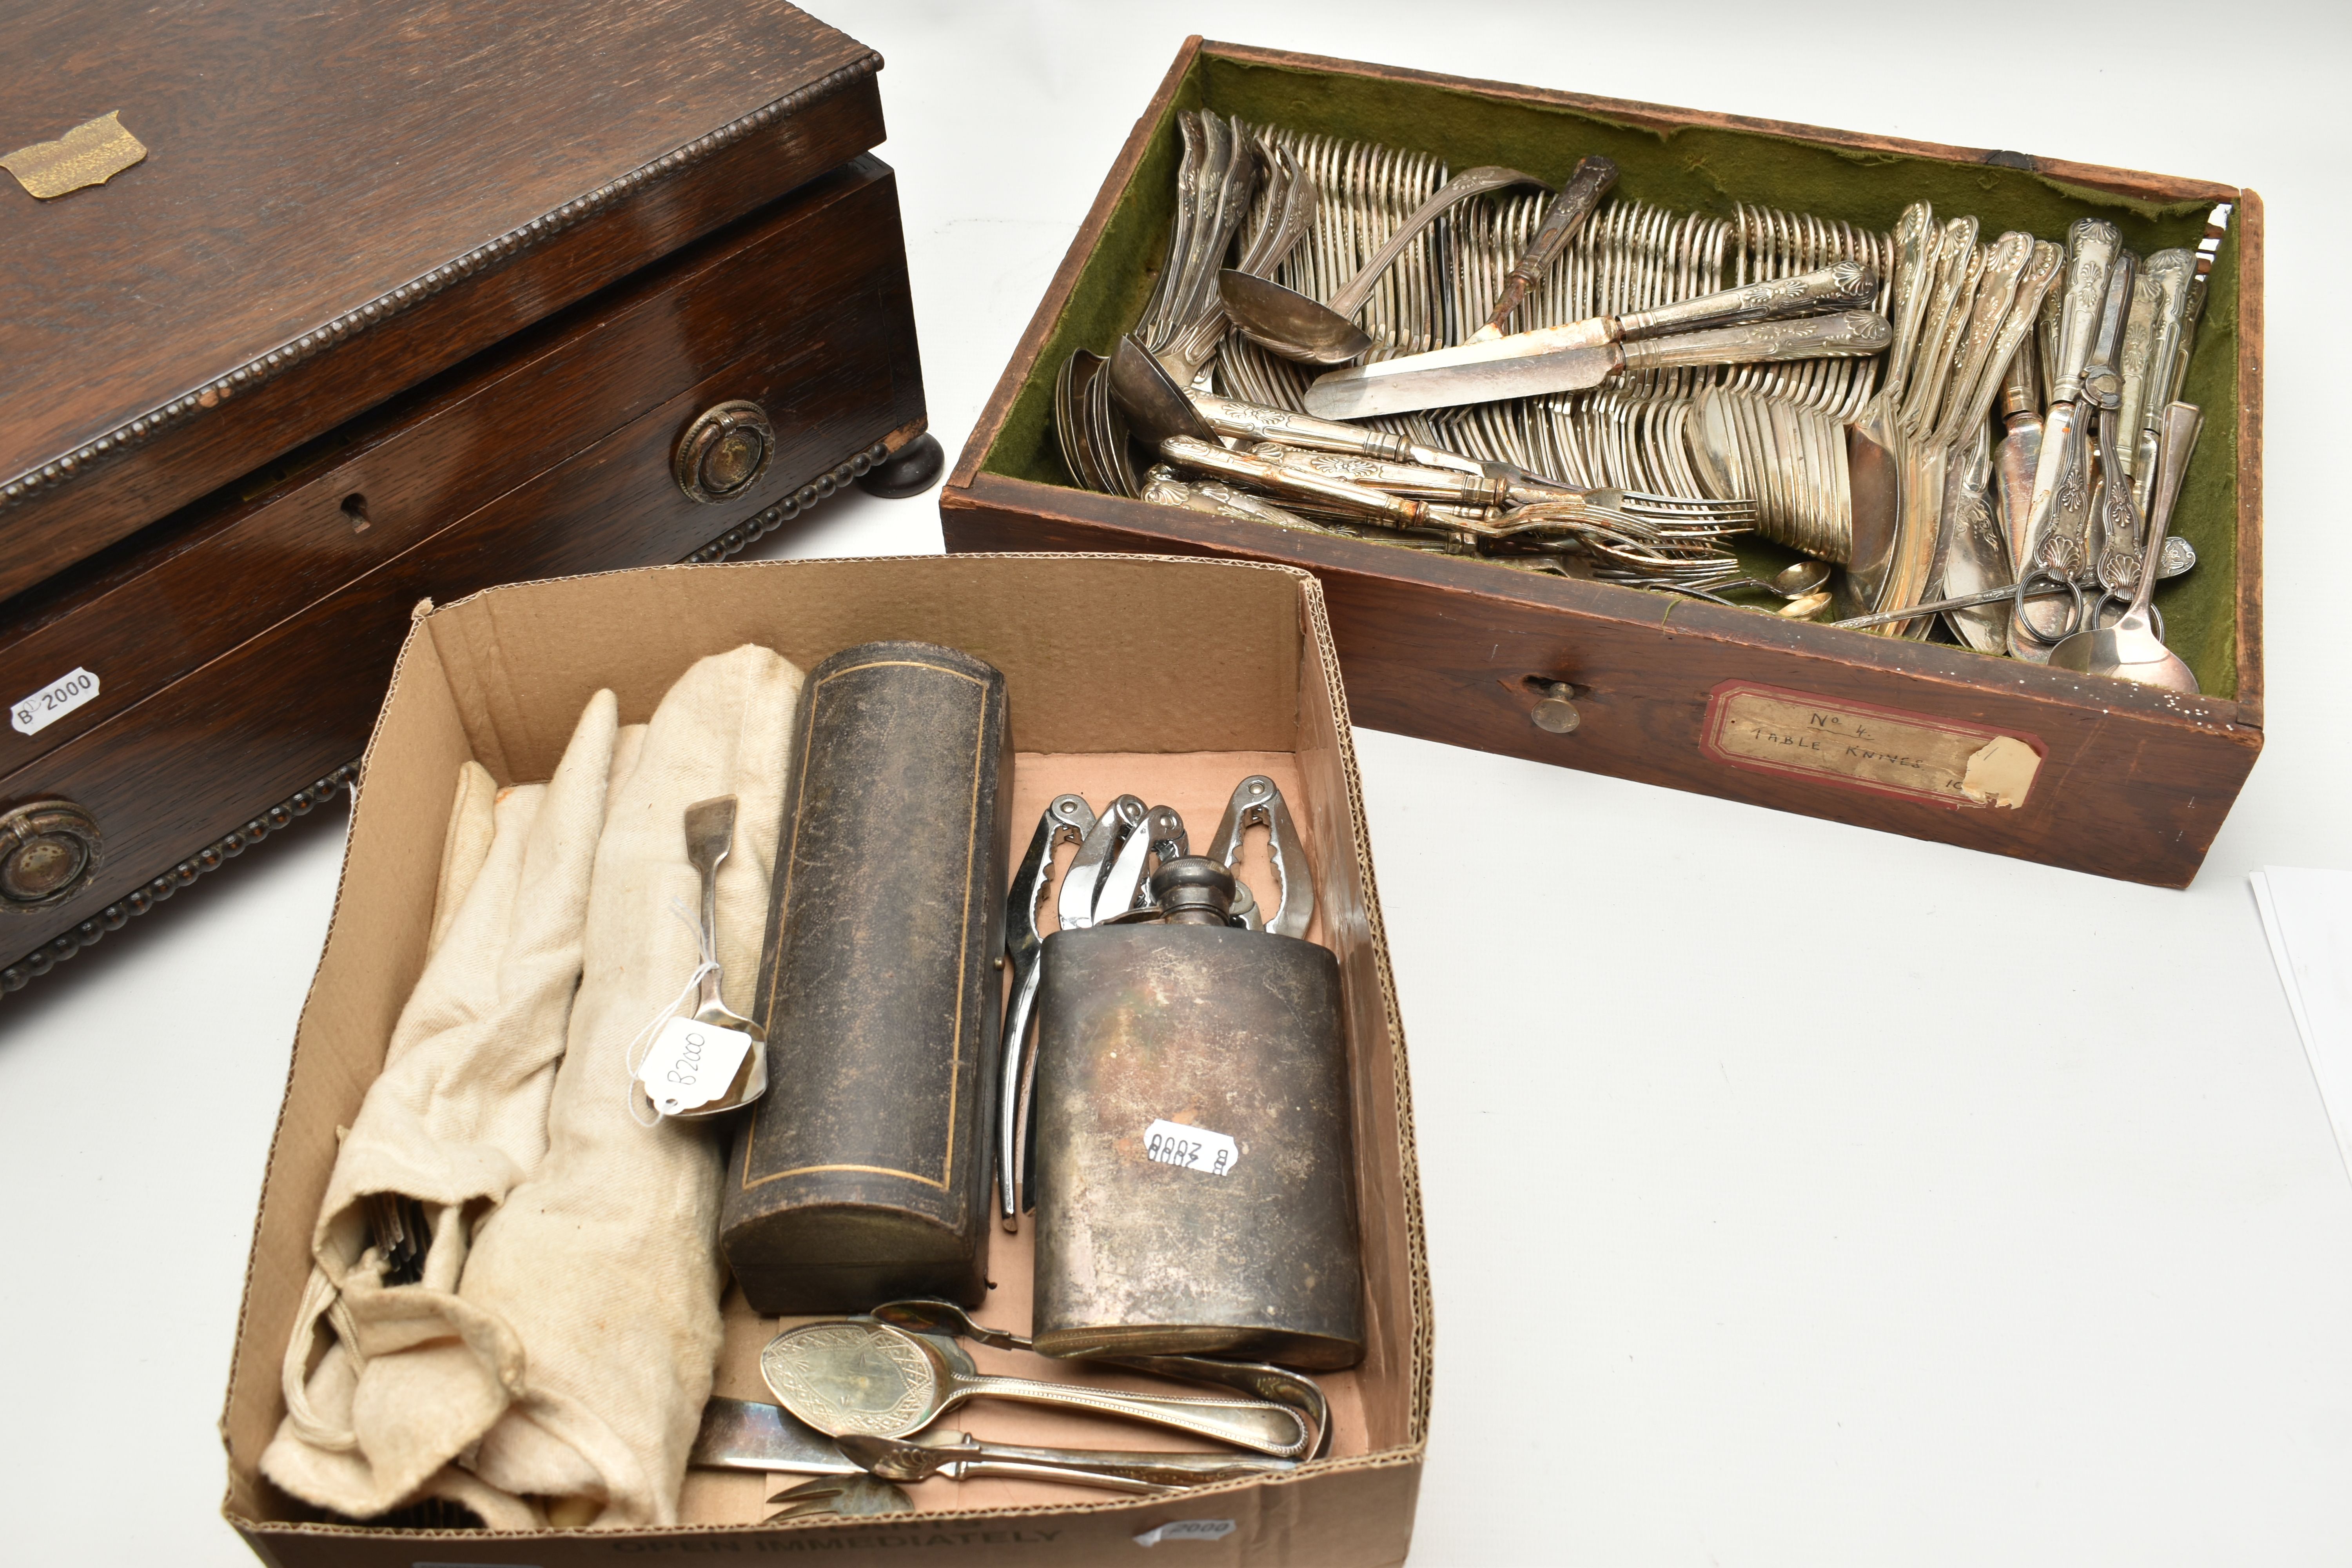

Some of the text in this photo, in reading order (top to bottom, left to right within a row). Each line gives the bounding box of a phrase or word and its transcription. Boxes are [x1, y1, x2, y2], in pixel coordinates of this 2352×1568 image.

[17, 675, 91, 724] B 2000
[1751, 726, 1820, 750] TABLE
[613, 1540, 741, 1553] OPEN
[755, 1529, 1062, 1552] IMMEDIATELY
